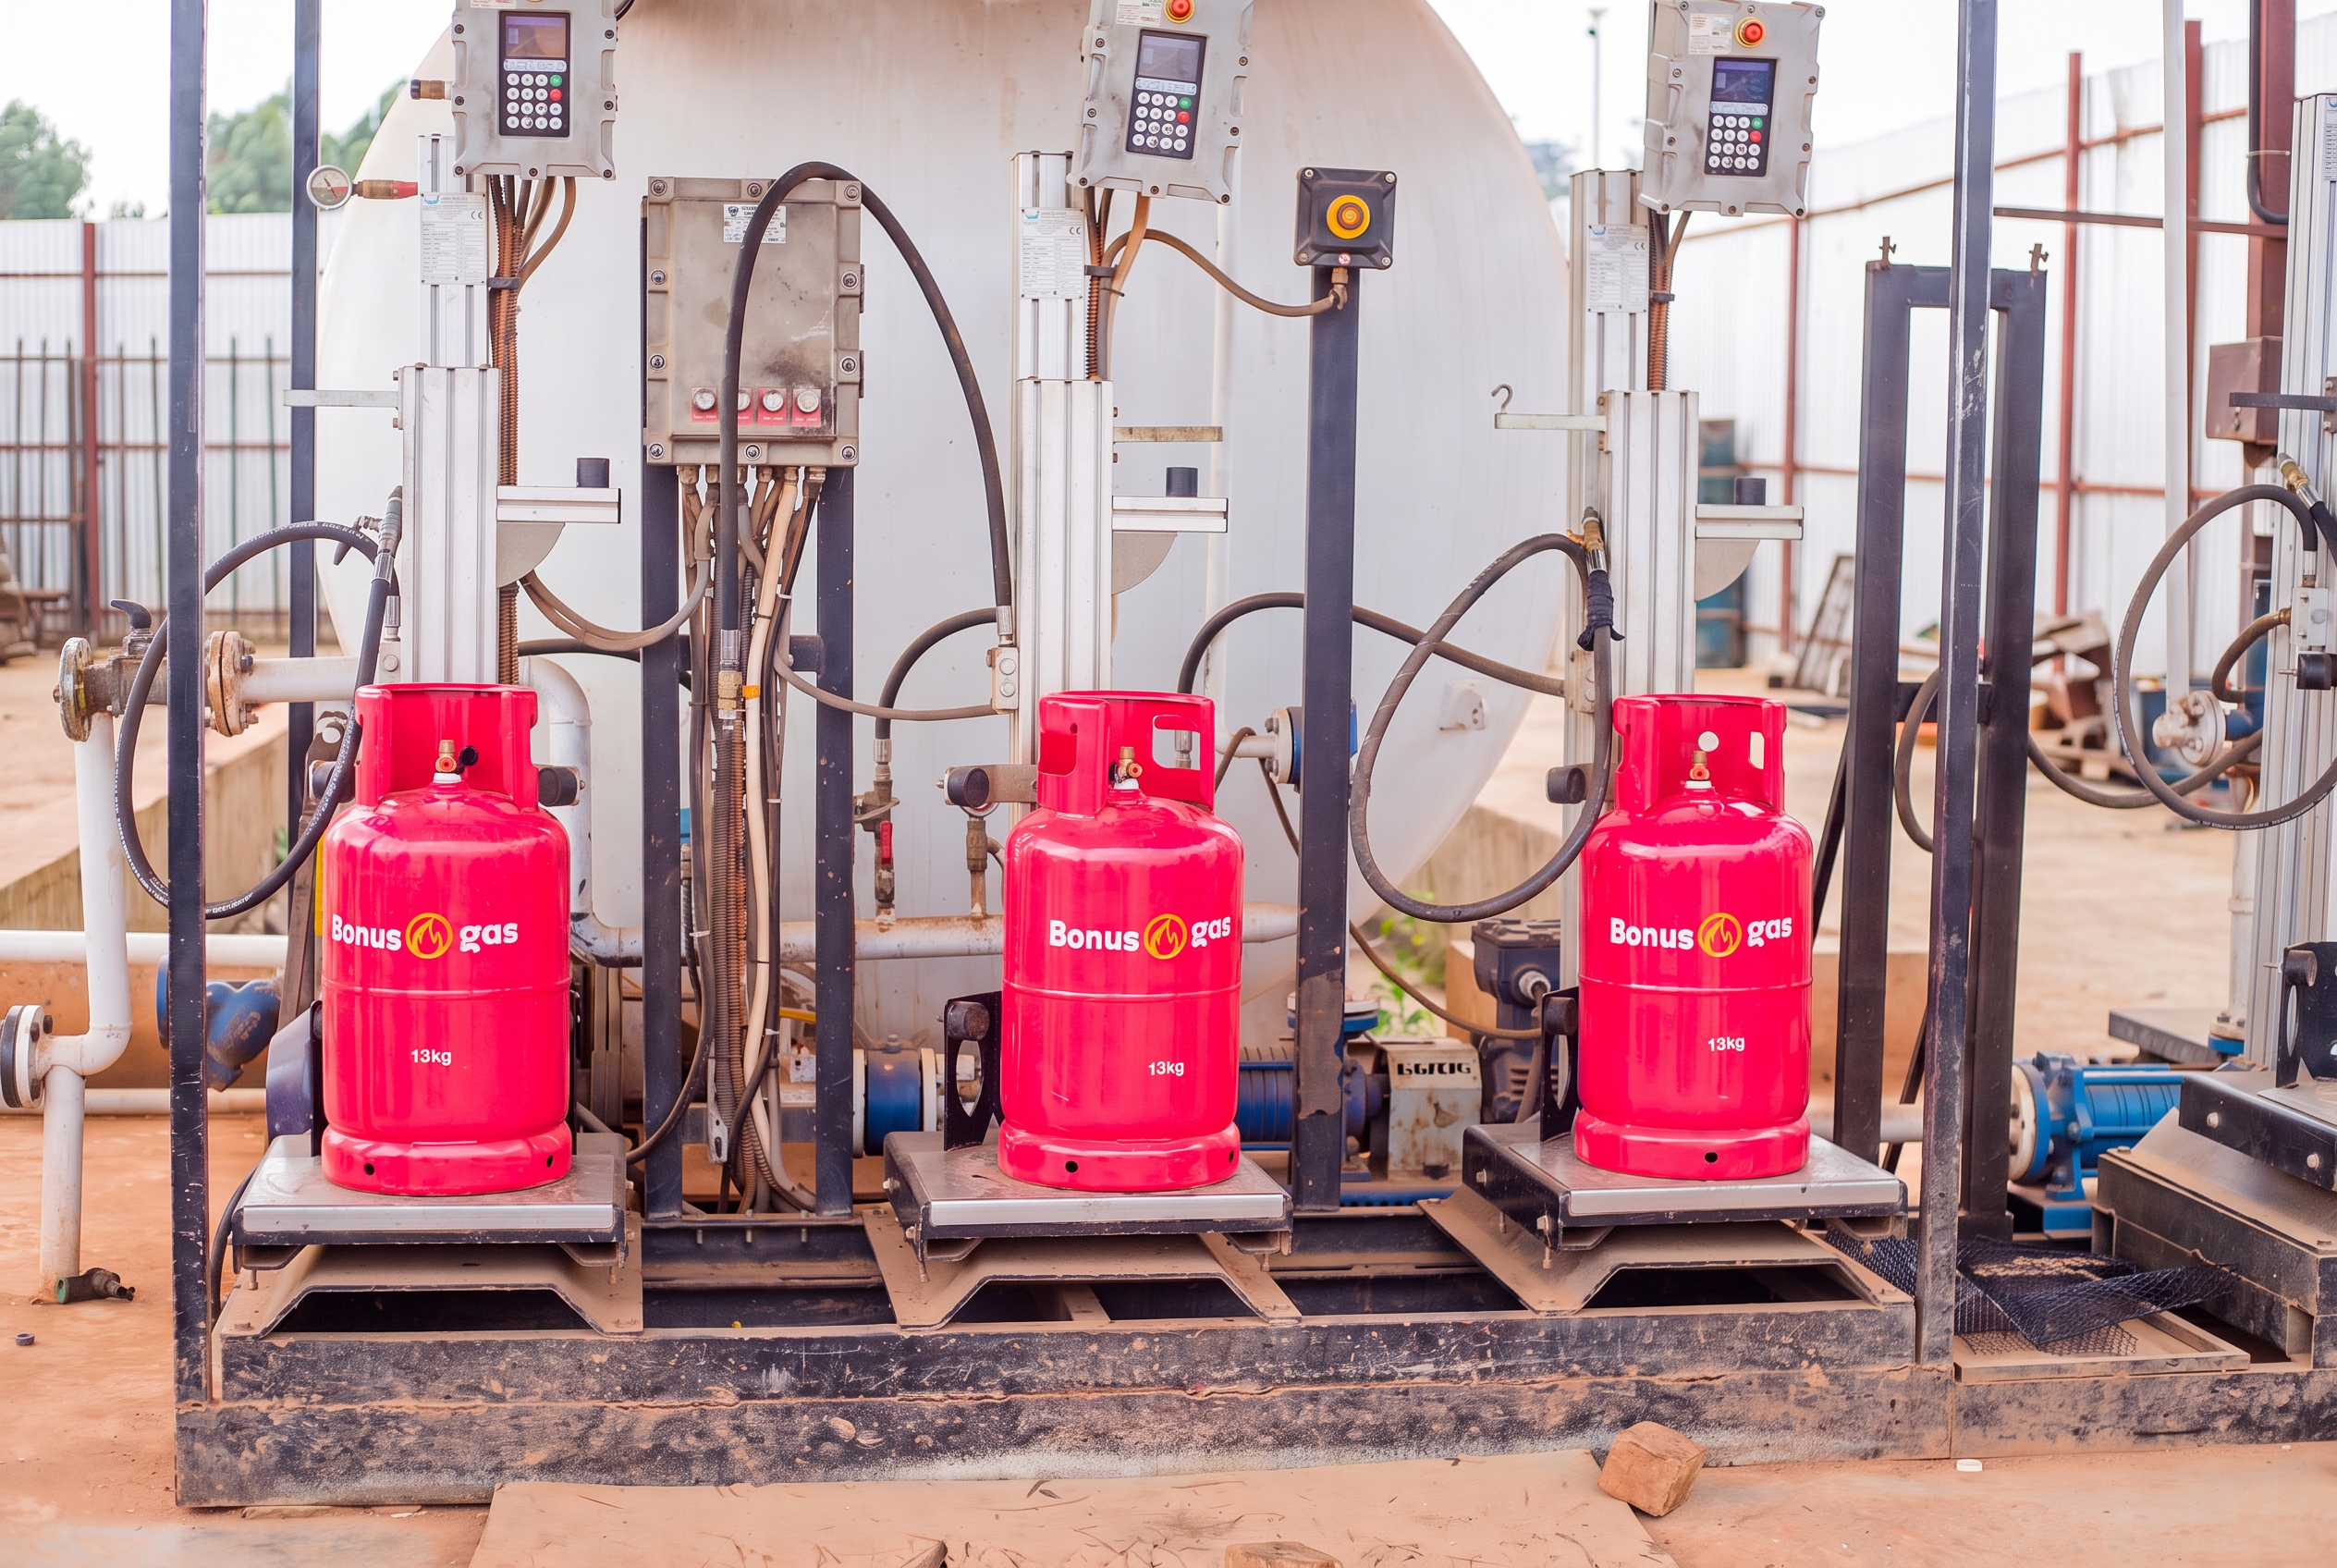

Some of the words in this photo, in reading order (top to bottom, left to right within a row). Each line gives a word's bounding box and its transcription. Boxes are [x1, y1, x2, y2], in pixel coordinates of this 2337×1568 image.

[331, 913, 402, 951] Bonus
[459, 923, 519, 954] gas
[1049, 919, 1140, 952] Bonus
[1191, 916, 1231, 948] gas
[1609, 917, 1695, 950] Bonus
[1747, 917, 1793, 948] gas
[1707, 1036, 1745, 1052] 13kg
[410, 1048, 452, 1066] 13kg
[1148, 1060, 1184, 1077] 13kg
